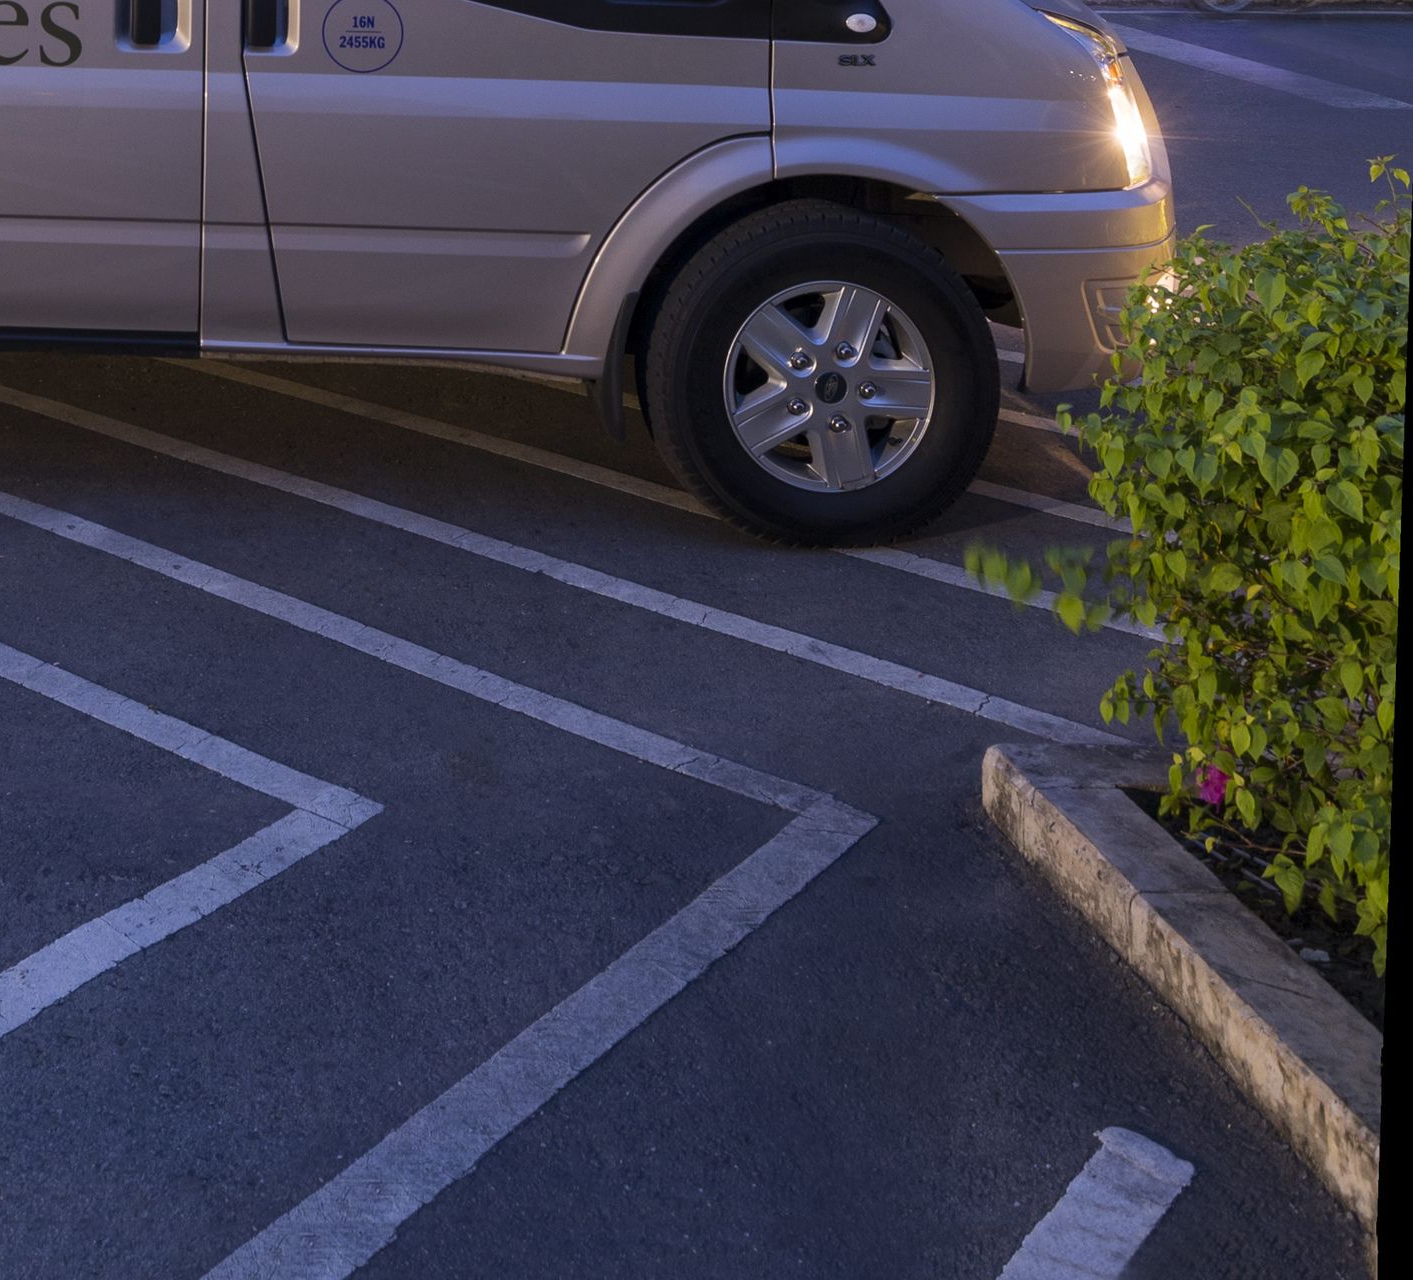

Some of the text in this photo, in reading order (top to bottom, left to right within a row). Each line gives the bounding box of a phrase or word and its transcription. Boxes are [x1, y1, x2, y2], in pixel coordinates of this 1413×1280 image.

[351, 15, 375, 28] 16N
[339, 35, 385, 49] 2455KG
[838, 54, 876, 67] SLX
